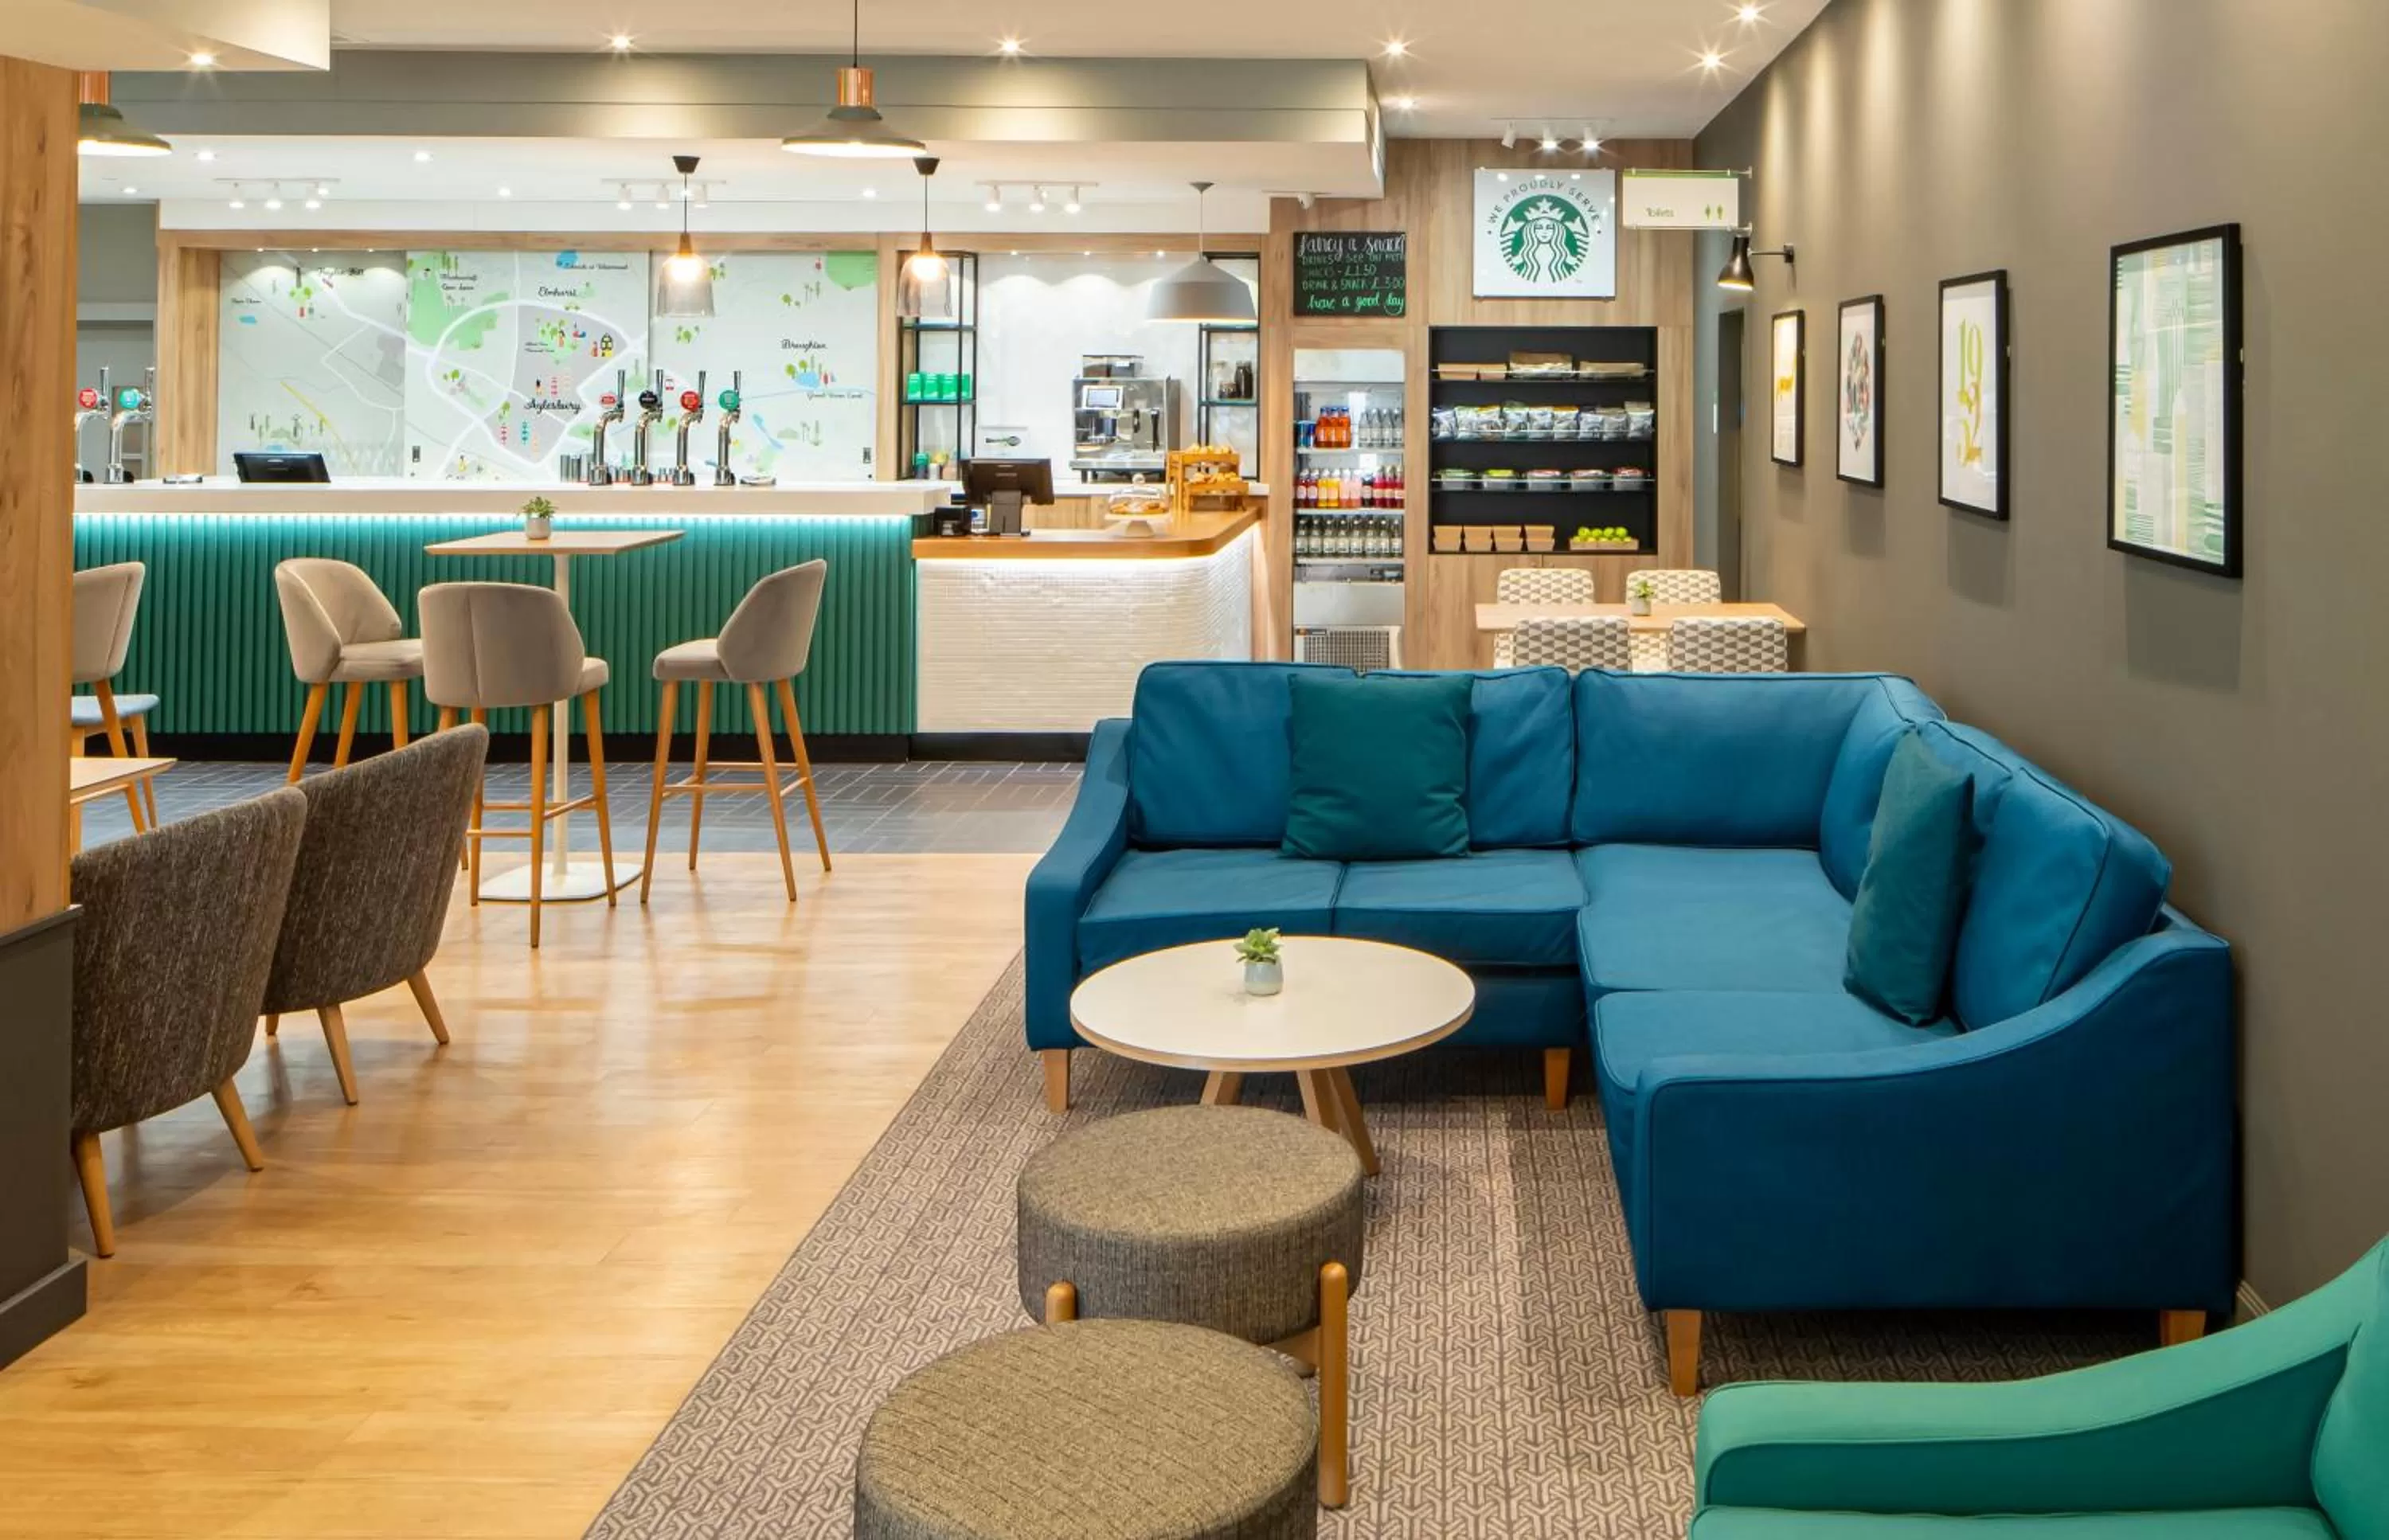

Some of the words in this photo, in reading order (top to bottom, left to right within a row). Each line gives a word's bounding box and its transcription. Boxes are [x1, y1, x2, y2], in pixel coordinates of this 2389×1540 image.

[1488, 205, 1503, 224] WE
[1503, 179, 1566, 203] PROUDLY
[1568, 187, 1600, 221] SERVE
[1297, 234, 1344, 262] fancy
[1348, 237, 1358, 252] a
[538, 286, 577, 298] Elmhurst
[524, 397, 581, 415] Aylesbury
